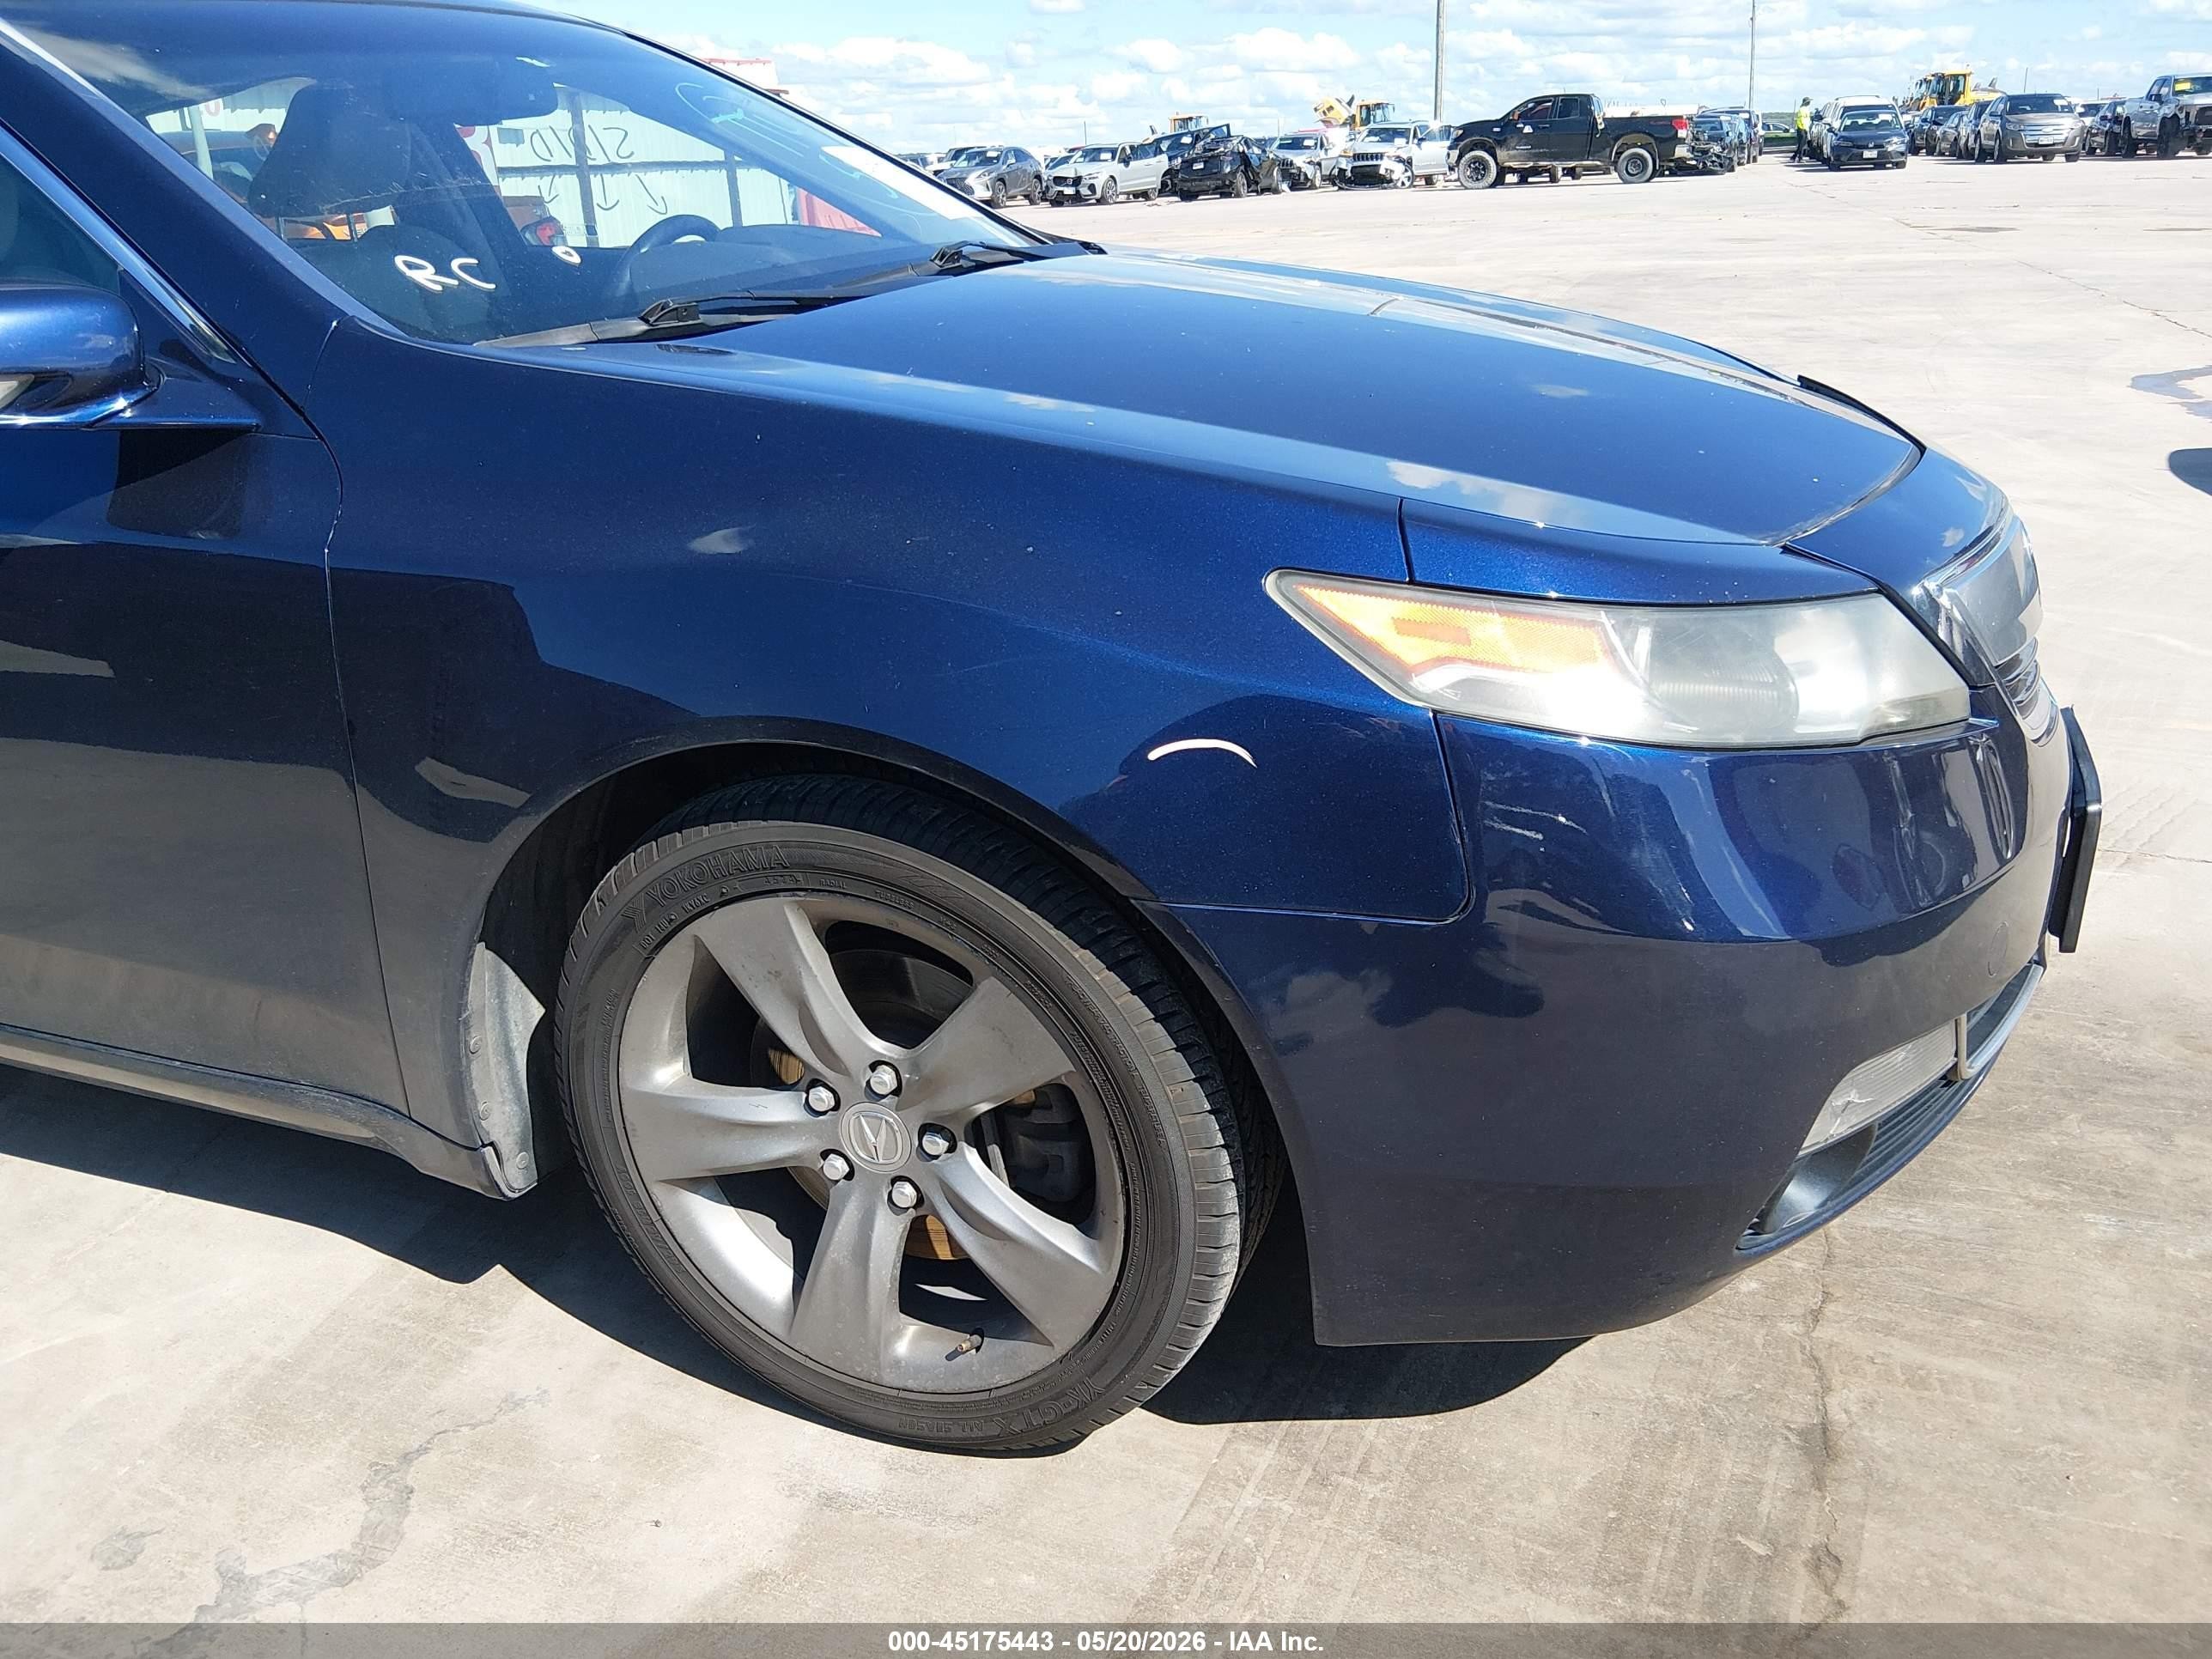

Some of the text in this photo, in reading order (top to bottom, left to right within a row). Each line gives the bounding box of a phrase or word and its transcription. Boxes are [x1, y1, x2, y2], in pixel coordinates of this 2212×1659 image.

[645, 844, 790, 909] YOKOHAMA
[896, 1415, 955, 1433] SEASON
[957, 1419, 987, 1433] ALL
